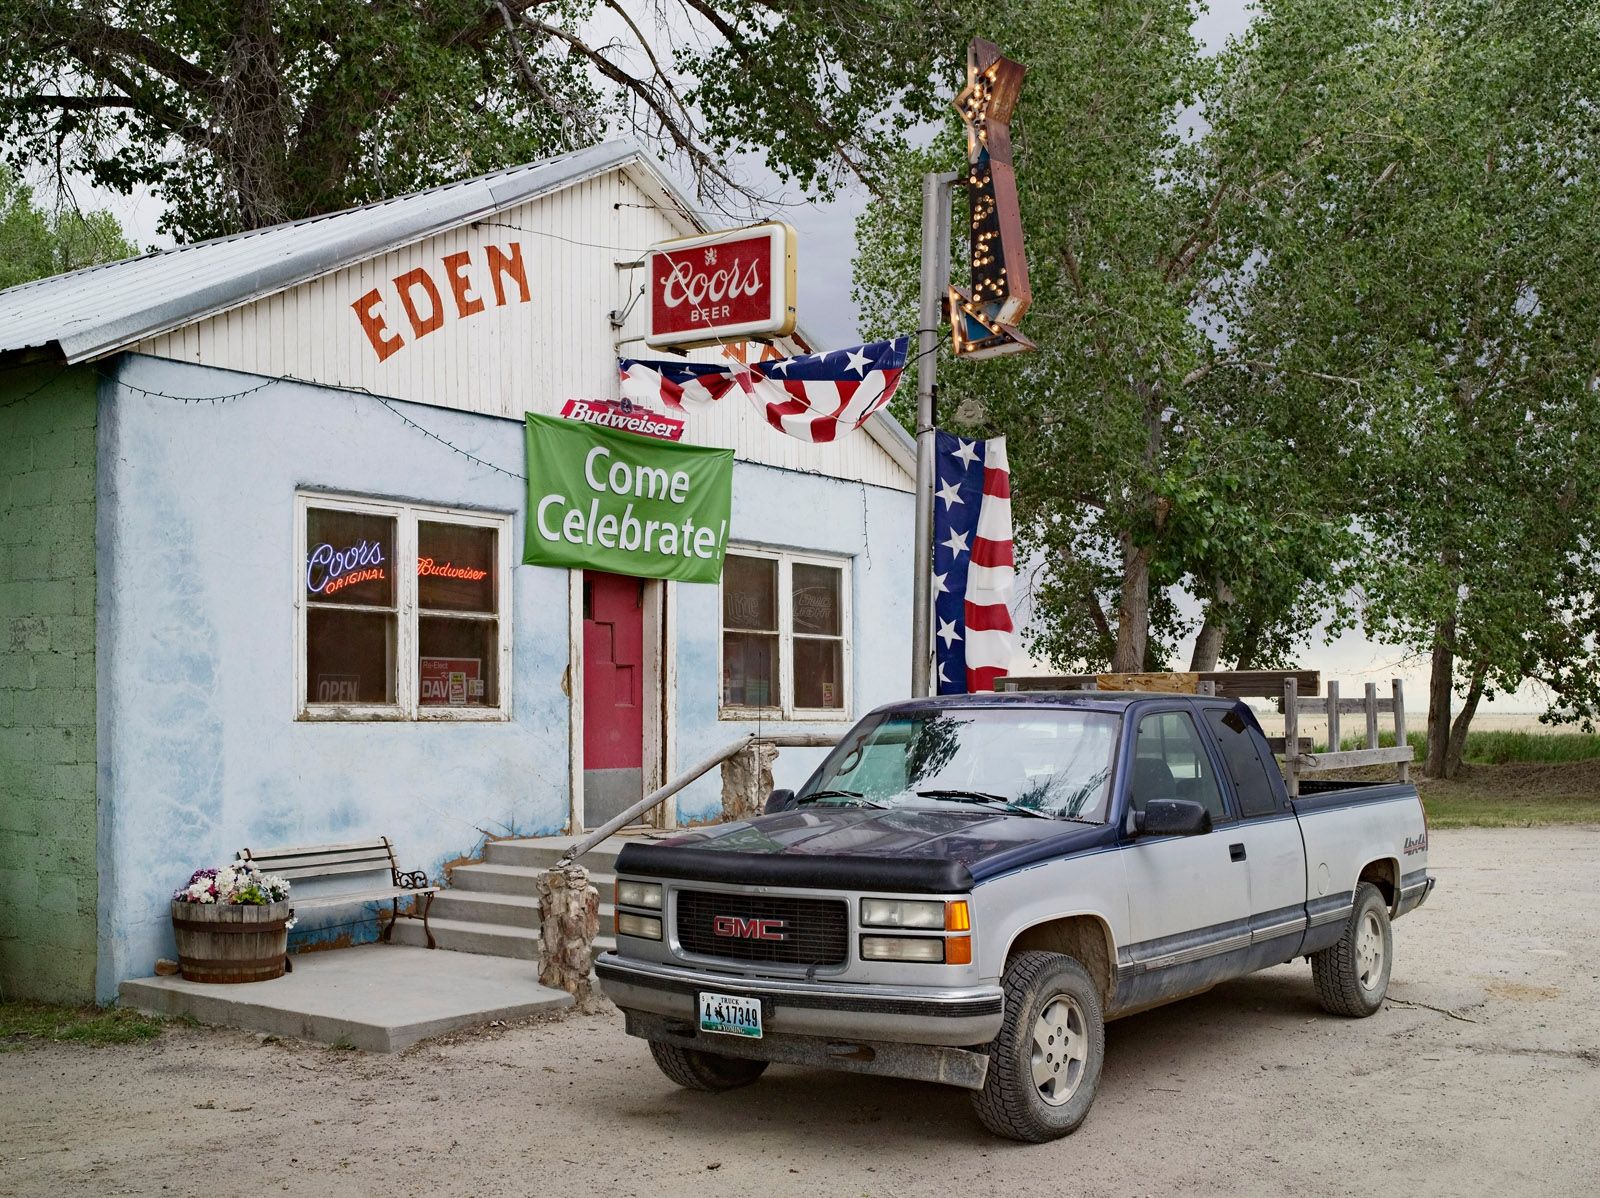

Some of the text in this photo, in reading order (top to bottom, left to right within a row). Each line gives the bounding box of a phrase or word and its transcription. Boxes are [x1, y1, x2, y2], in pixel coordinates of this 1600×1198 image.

[660, 258, 763, 308] Coors
[351, 242, 531, 364] EDEN
[690, 305, 730, 322] BEER
[569, 401, 677, 437] Budweiser
[584, 446, 690, 504] Come
[537, 494, 726, 560] Celebrate!
[306, 540, 385, 593] Coors
[417, 557, 487, 581] Budweiser
[326, 569, 385, 594] ORIGINAL
[318, 680, 358, 702] OPEN
[713, 915, 784, 941] GMC
[720, 997, 740, 1005] TRUCK
[726, 1005, 758, 1027] 17349
